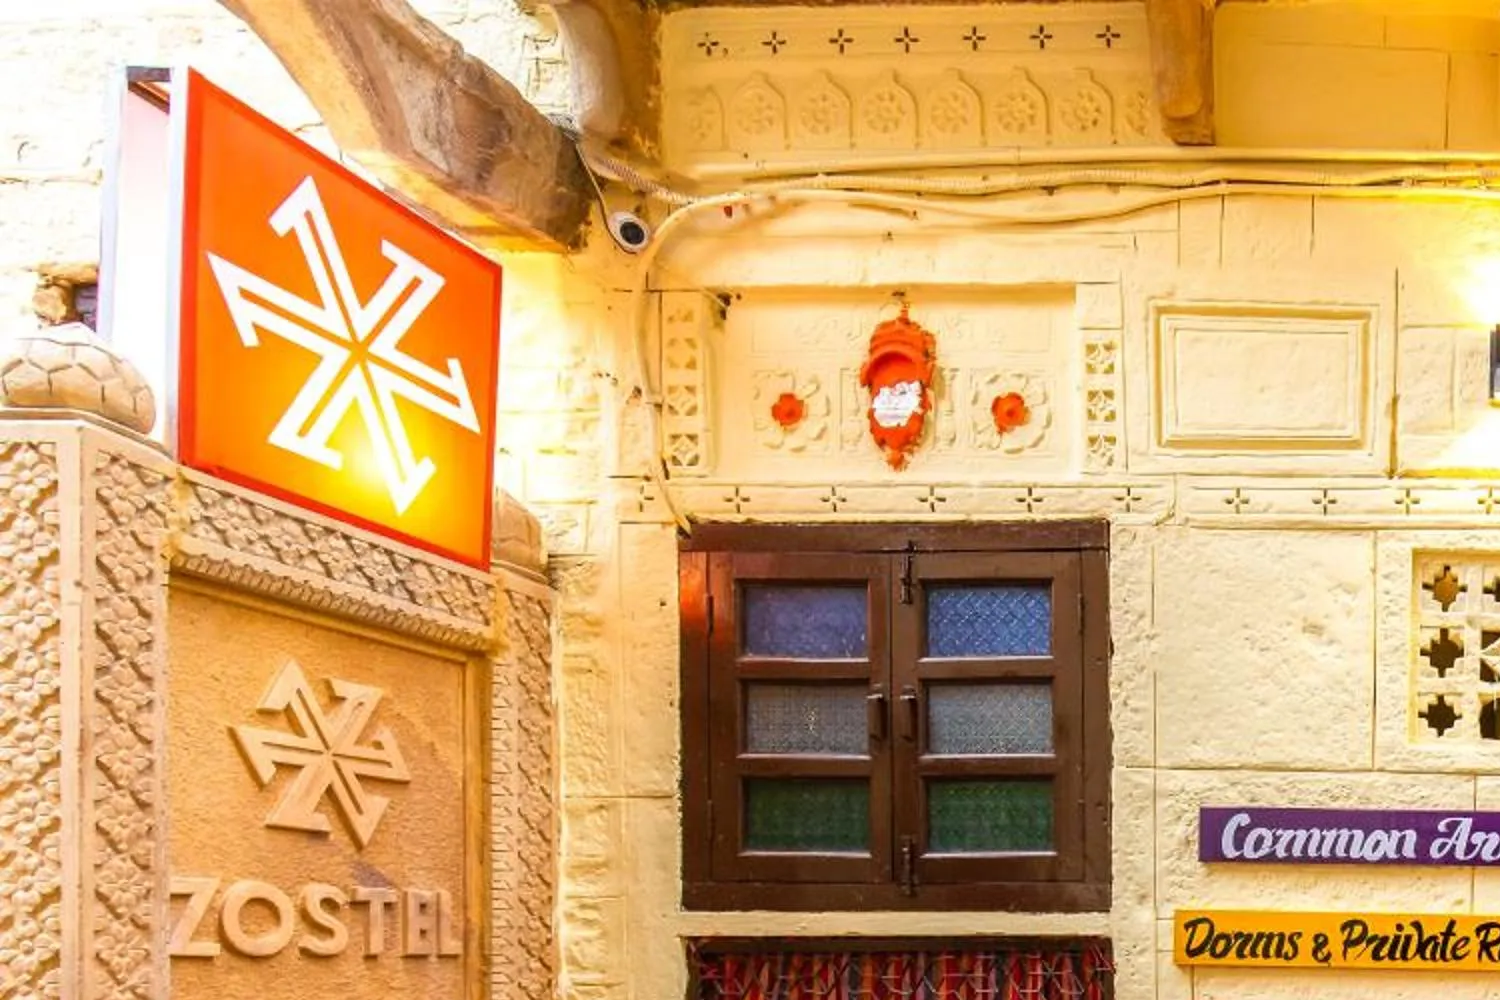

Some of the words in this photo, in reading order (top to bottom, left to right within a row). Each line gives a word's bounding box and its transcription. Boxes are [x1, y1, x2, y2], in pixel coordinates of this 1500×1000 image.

[1220, 812, 1417, 861] Common
[168, 876, 461, 958] ZOSTEL
[1183, 916, 1303, 960] Dorms
[1311, 932, 1333, 967] &
[1339, 918, 1471, 965] Private
